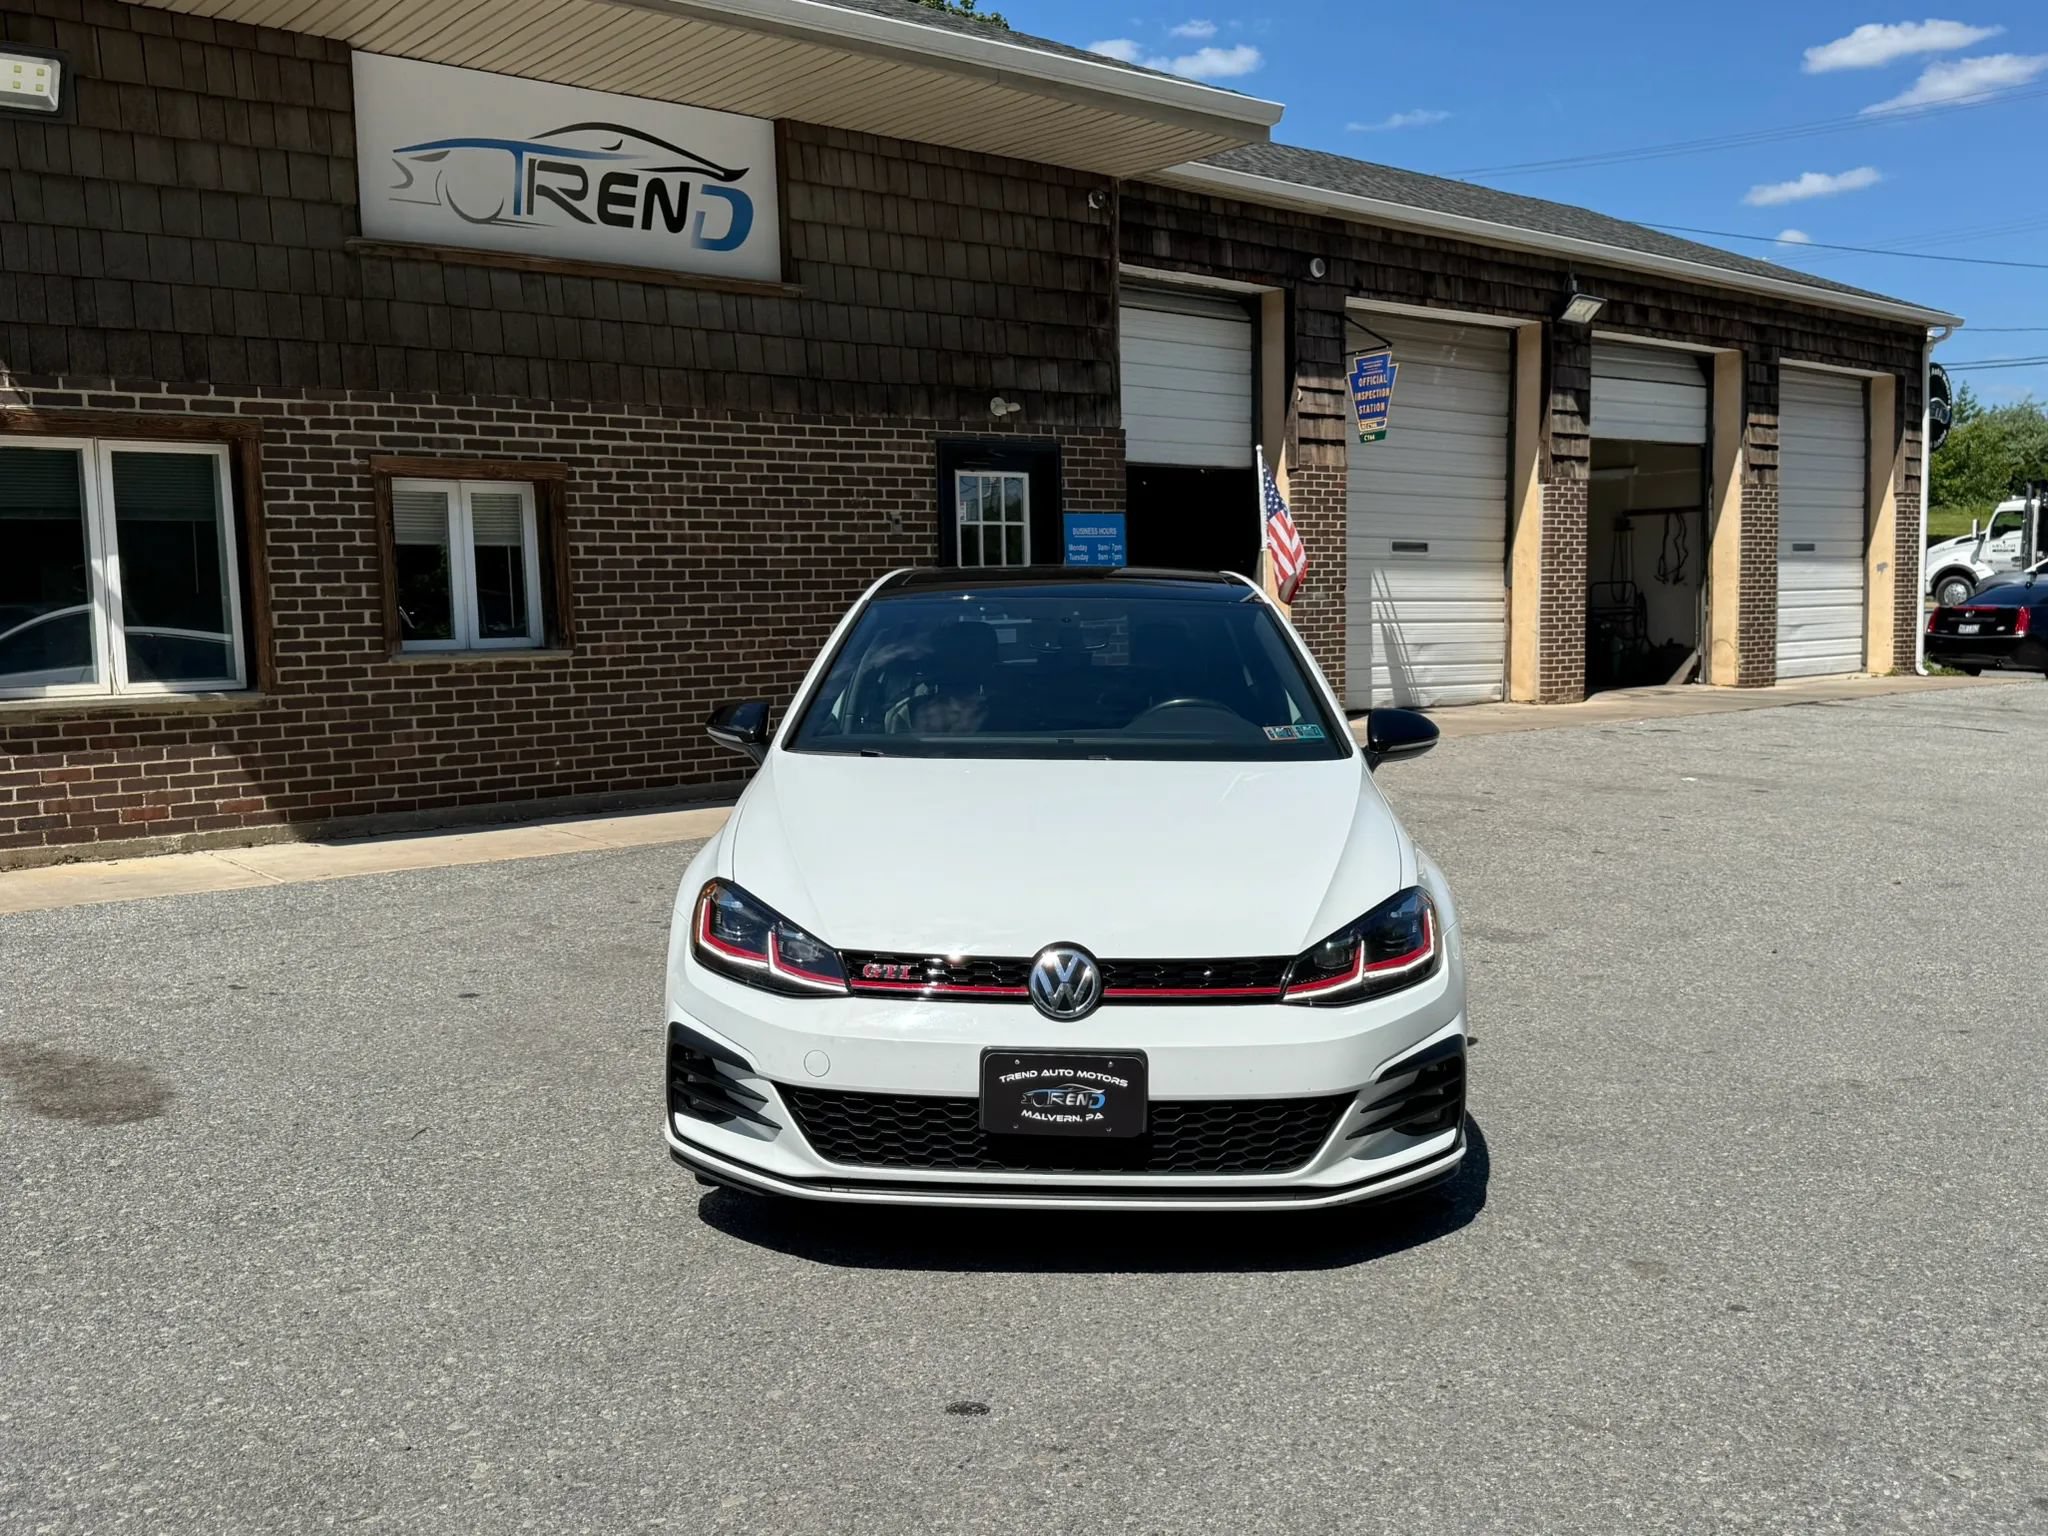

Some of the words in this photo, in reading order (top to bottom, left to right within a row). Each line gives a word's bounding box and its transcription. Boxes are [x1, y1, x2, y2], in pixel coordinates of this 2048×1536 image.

[506, 142, 754, 252] TREND
[1358, 373, 1387, 387] OFFICIAL
[1354, 387, 1390, 401] INSPECTION
[1358, 402, 1385, 414] STATION
[1072, 527, 1098, 535] BUSINESS
[1098, 527, 1117, 535] HOURS
[1068, 544, 1088, 553] Monday
[1068, 553, 1089, 562] Tuesday
[862, 963, 912, 979] GTI
[999, 1069, 1038, 1084] TREND
[1040, 1068, 1075, 1078] AUTO
[1076, 1070, 1129, 1088] MOTORS
[1042, 1089, 1106, 1109] TREND
[1085, 1111, 1105, 1122] PA
